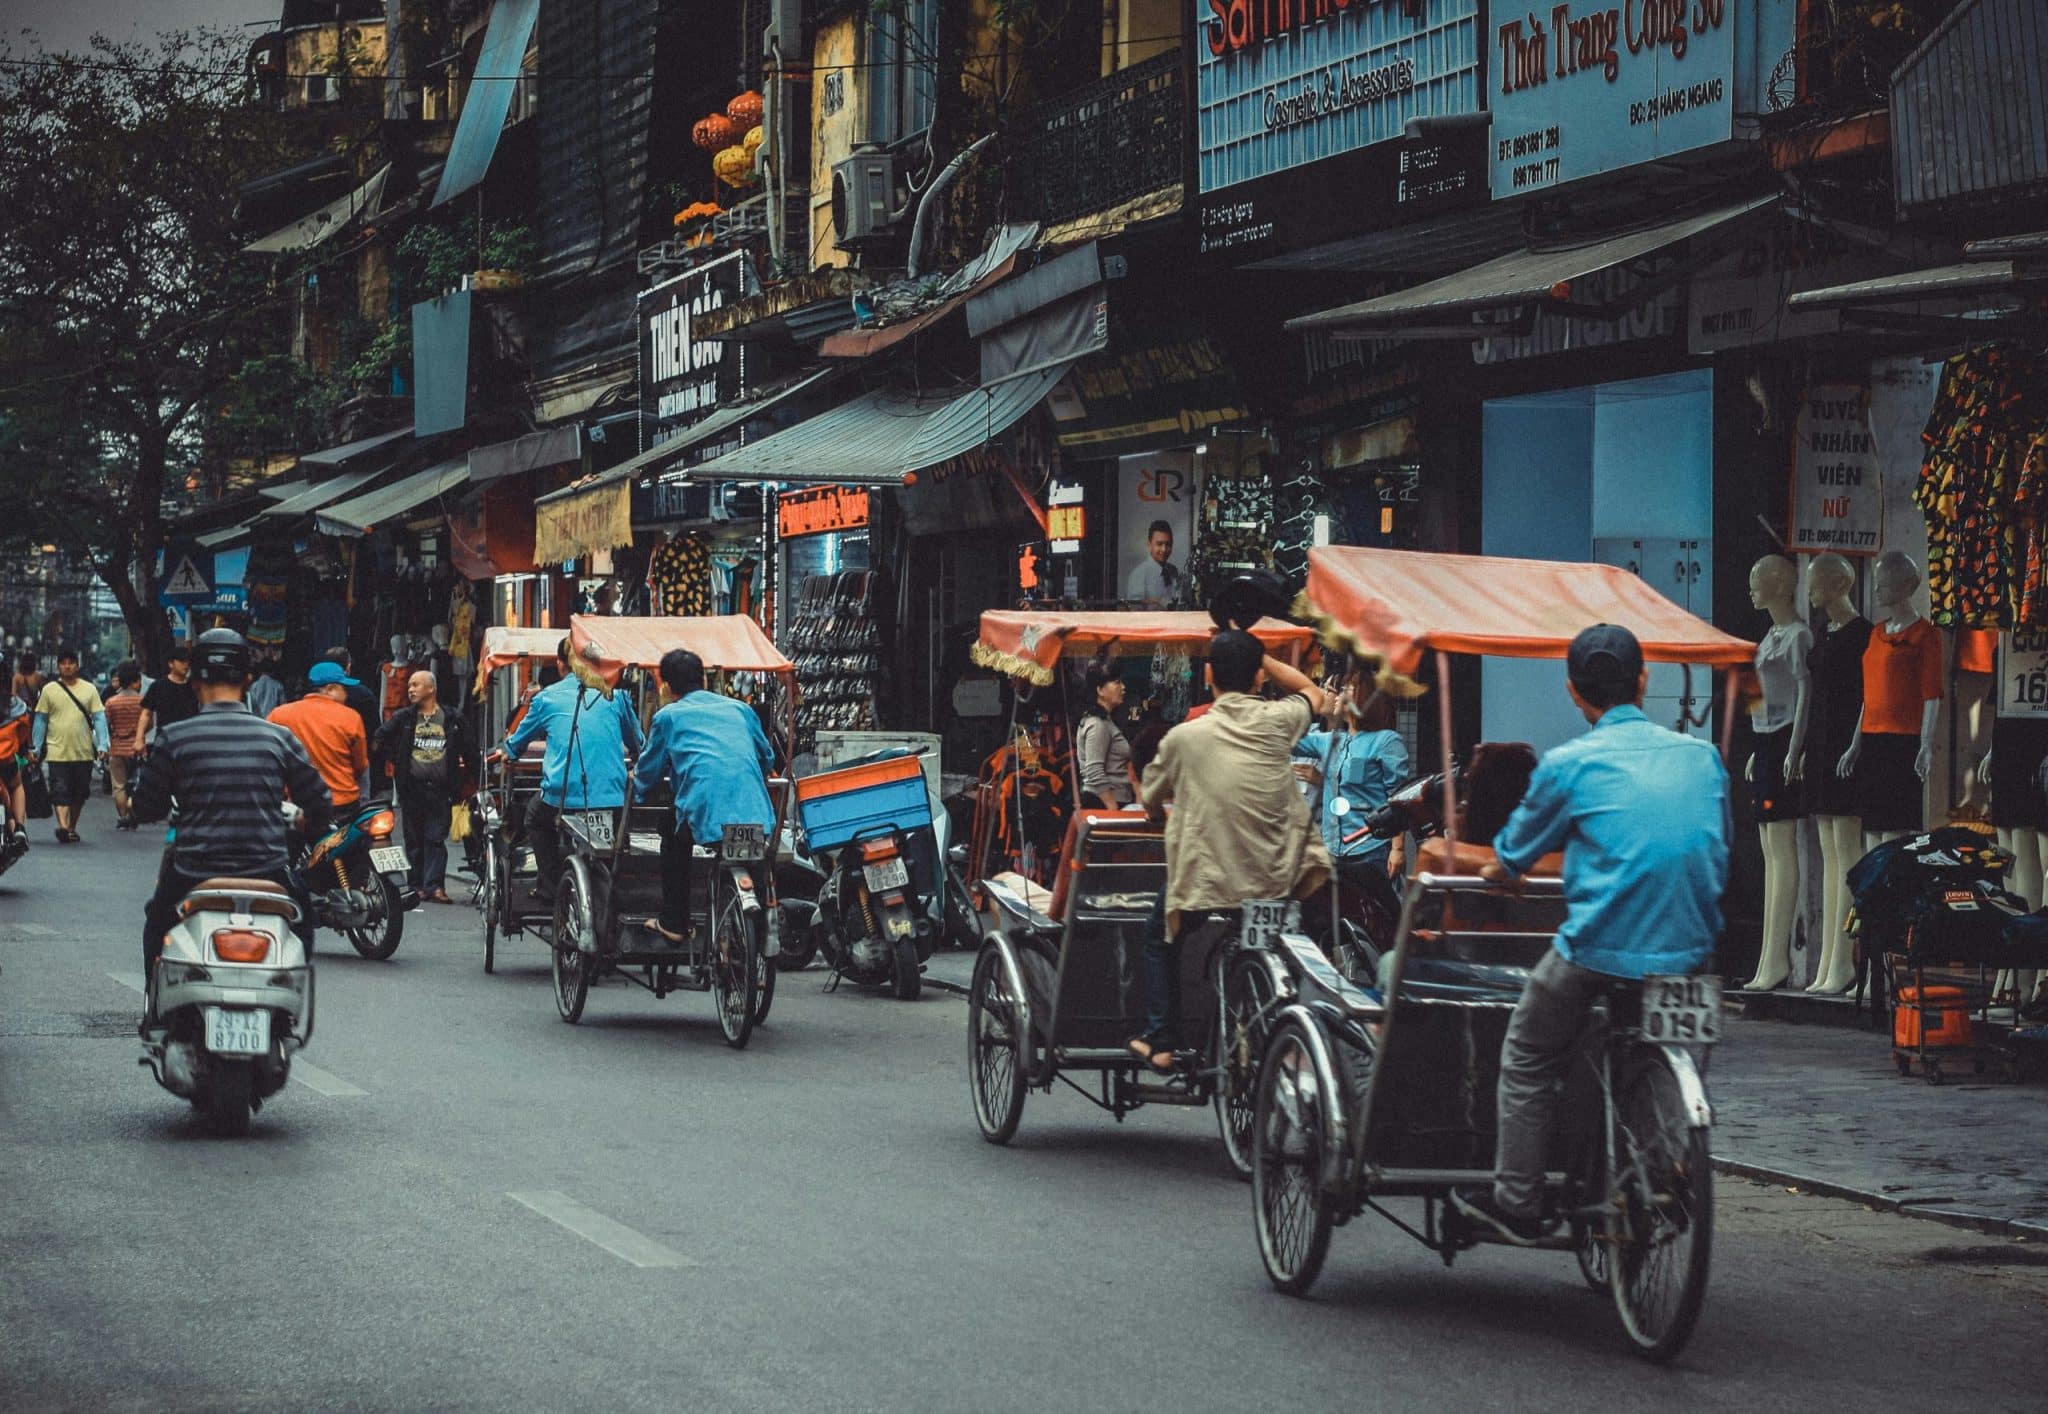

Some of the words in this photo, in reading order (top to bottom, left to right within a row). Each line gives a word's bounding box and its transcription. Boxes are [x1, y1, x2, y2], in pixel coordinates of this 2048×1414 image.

[1498, 12, 1548, 95] Thời
[1551, 3, 1620, 83] Trang
[1263, 83, 1318, 130] Cosmetic
[1322, 70, 1335, 113] &
[1339, 53, 1416, 107] Accessories
[1659, 86, 1687, 118] HÀNG
[1687, 77, 1724, 109] NGANG
[650, 294, 691, 384] THIÊN
[1811, 430, 1869, 454] NHÂN
[1817, 462, 1863, 487] VIÊN
[1822, 495, 1851, 519] NỮ
[215, 1031, 260, 1050] 8700
